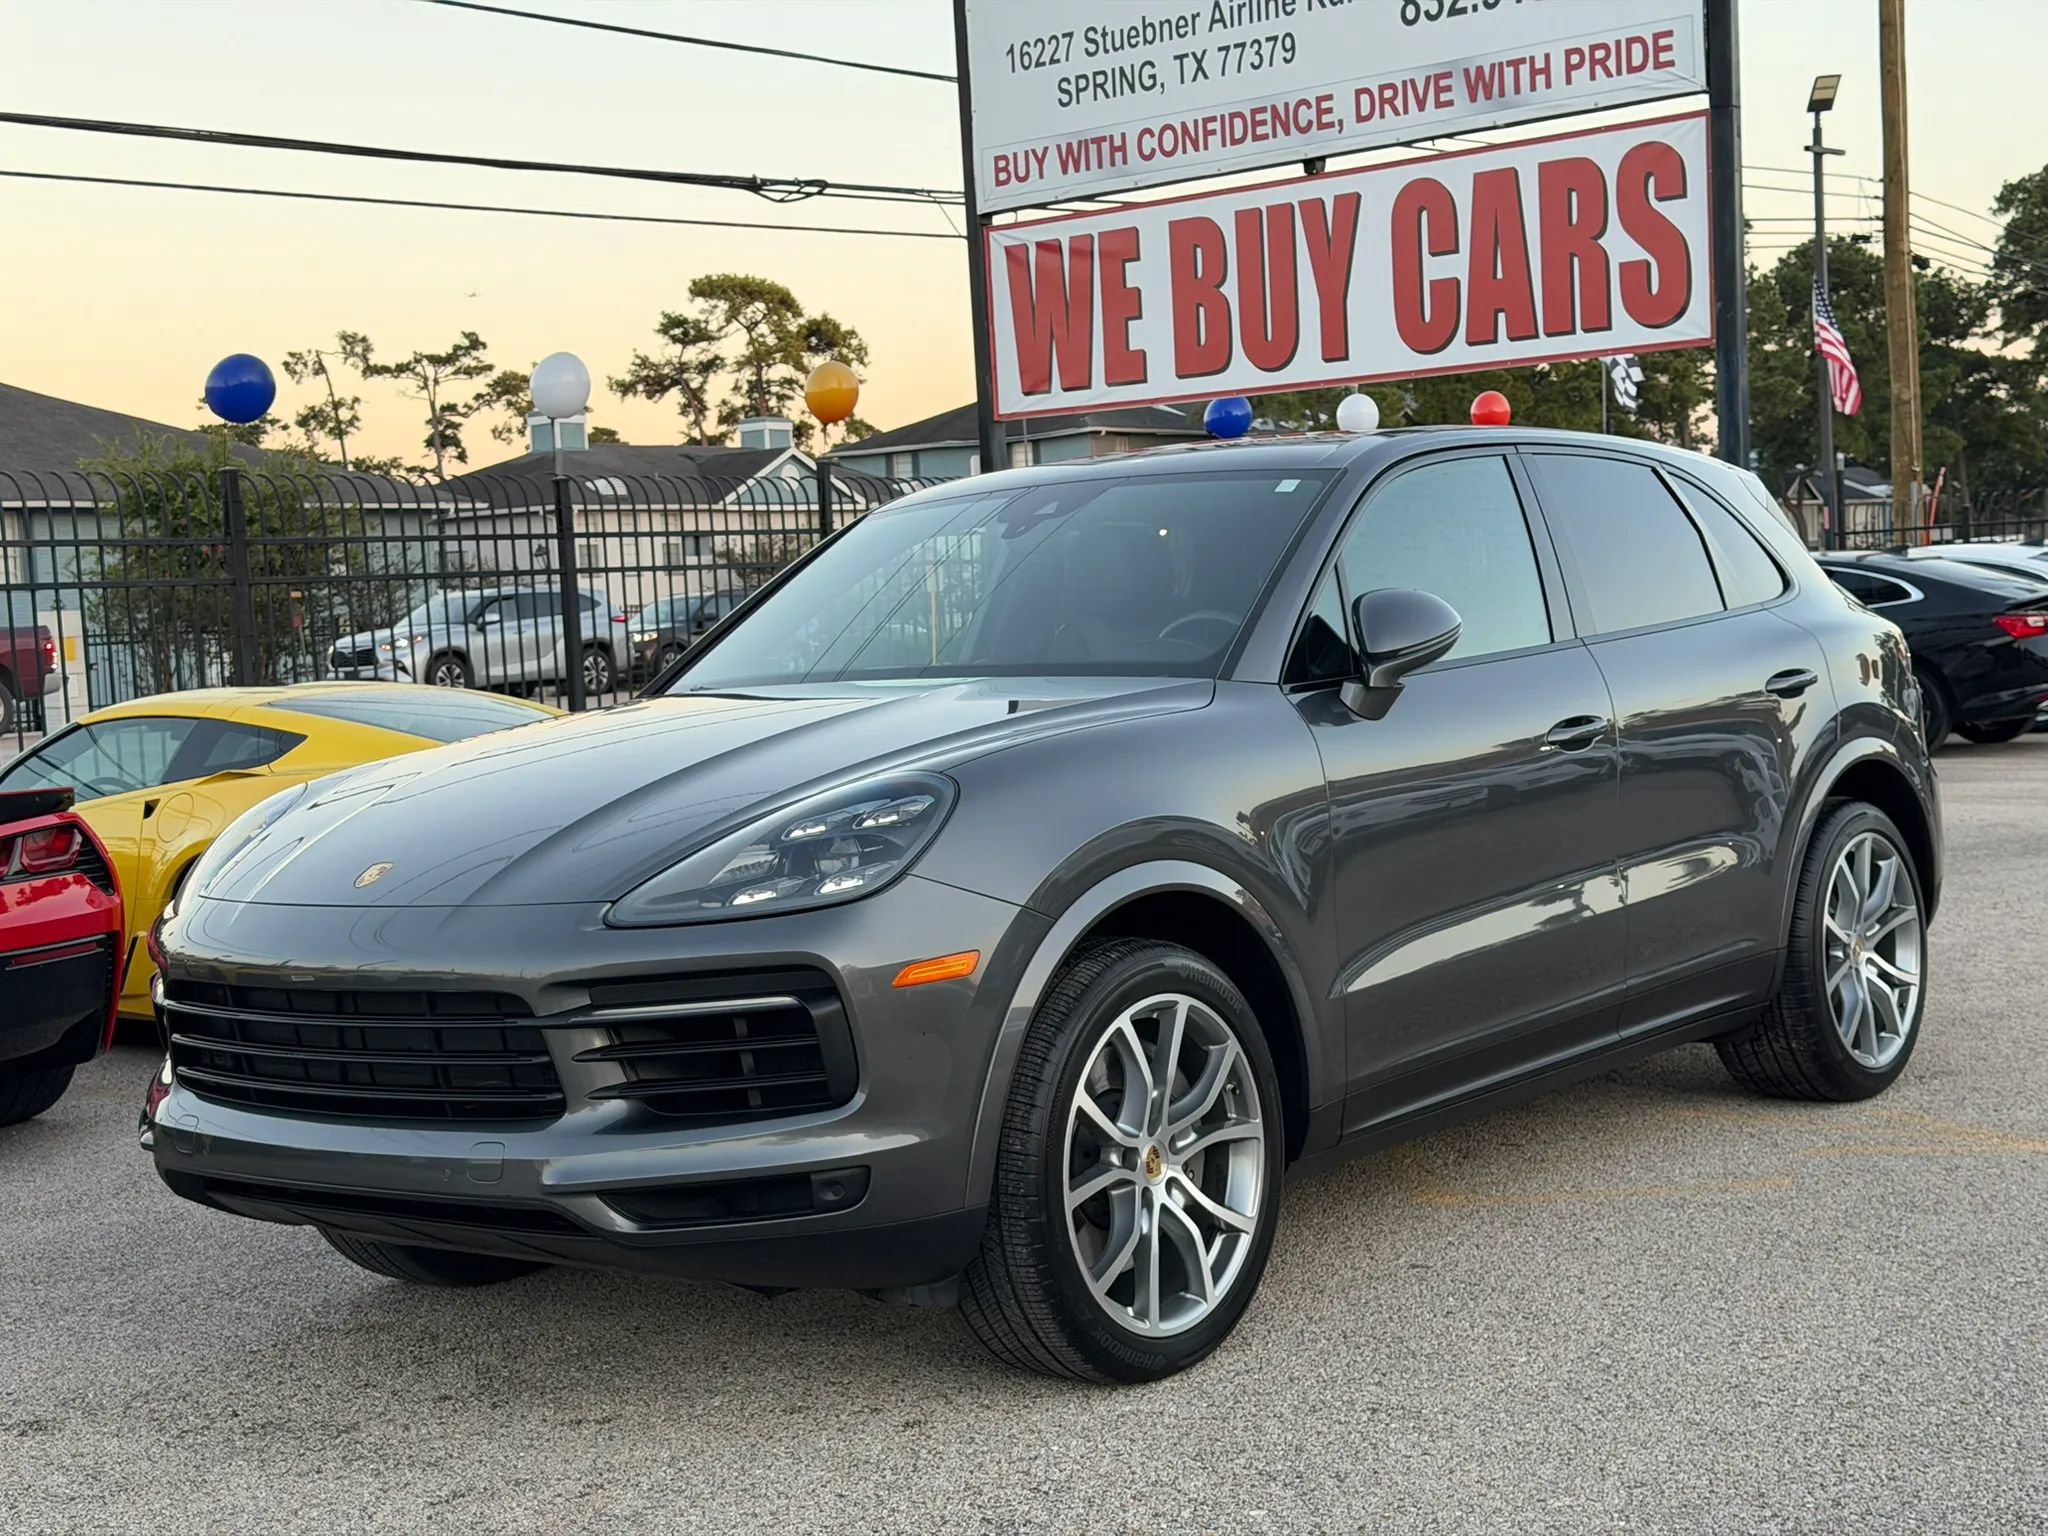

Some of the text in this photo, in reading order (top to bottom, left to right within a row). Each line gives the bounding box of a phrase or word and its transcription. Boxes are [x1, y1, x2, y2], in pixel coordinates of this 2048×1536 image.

[1006, 0, 1297, 73] 16227 Stuebner Airline
[1057, 32, 1297, 108] SPRING, TX 77379
[994, 30, 1676, 187] BUY WITH CONFIDENCE, DRIVE WITH PRIDE
[1004, 140, 1692, 396] WE BUY CARS
